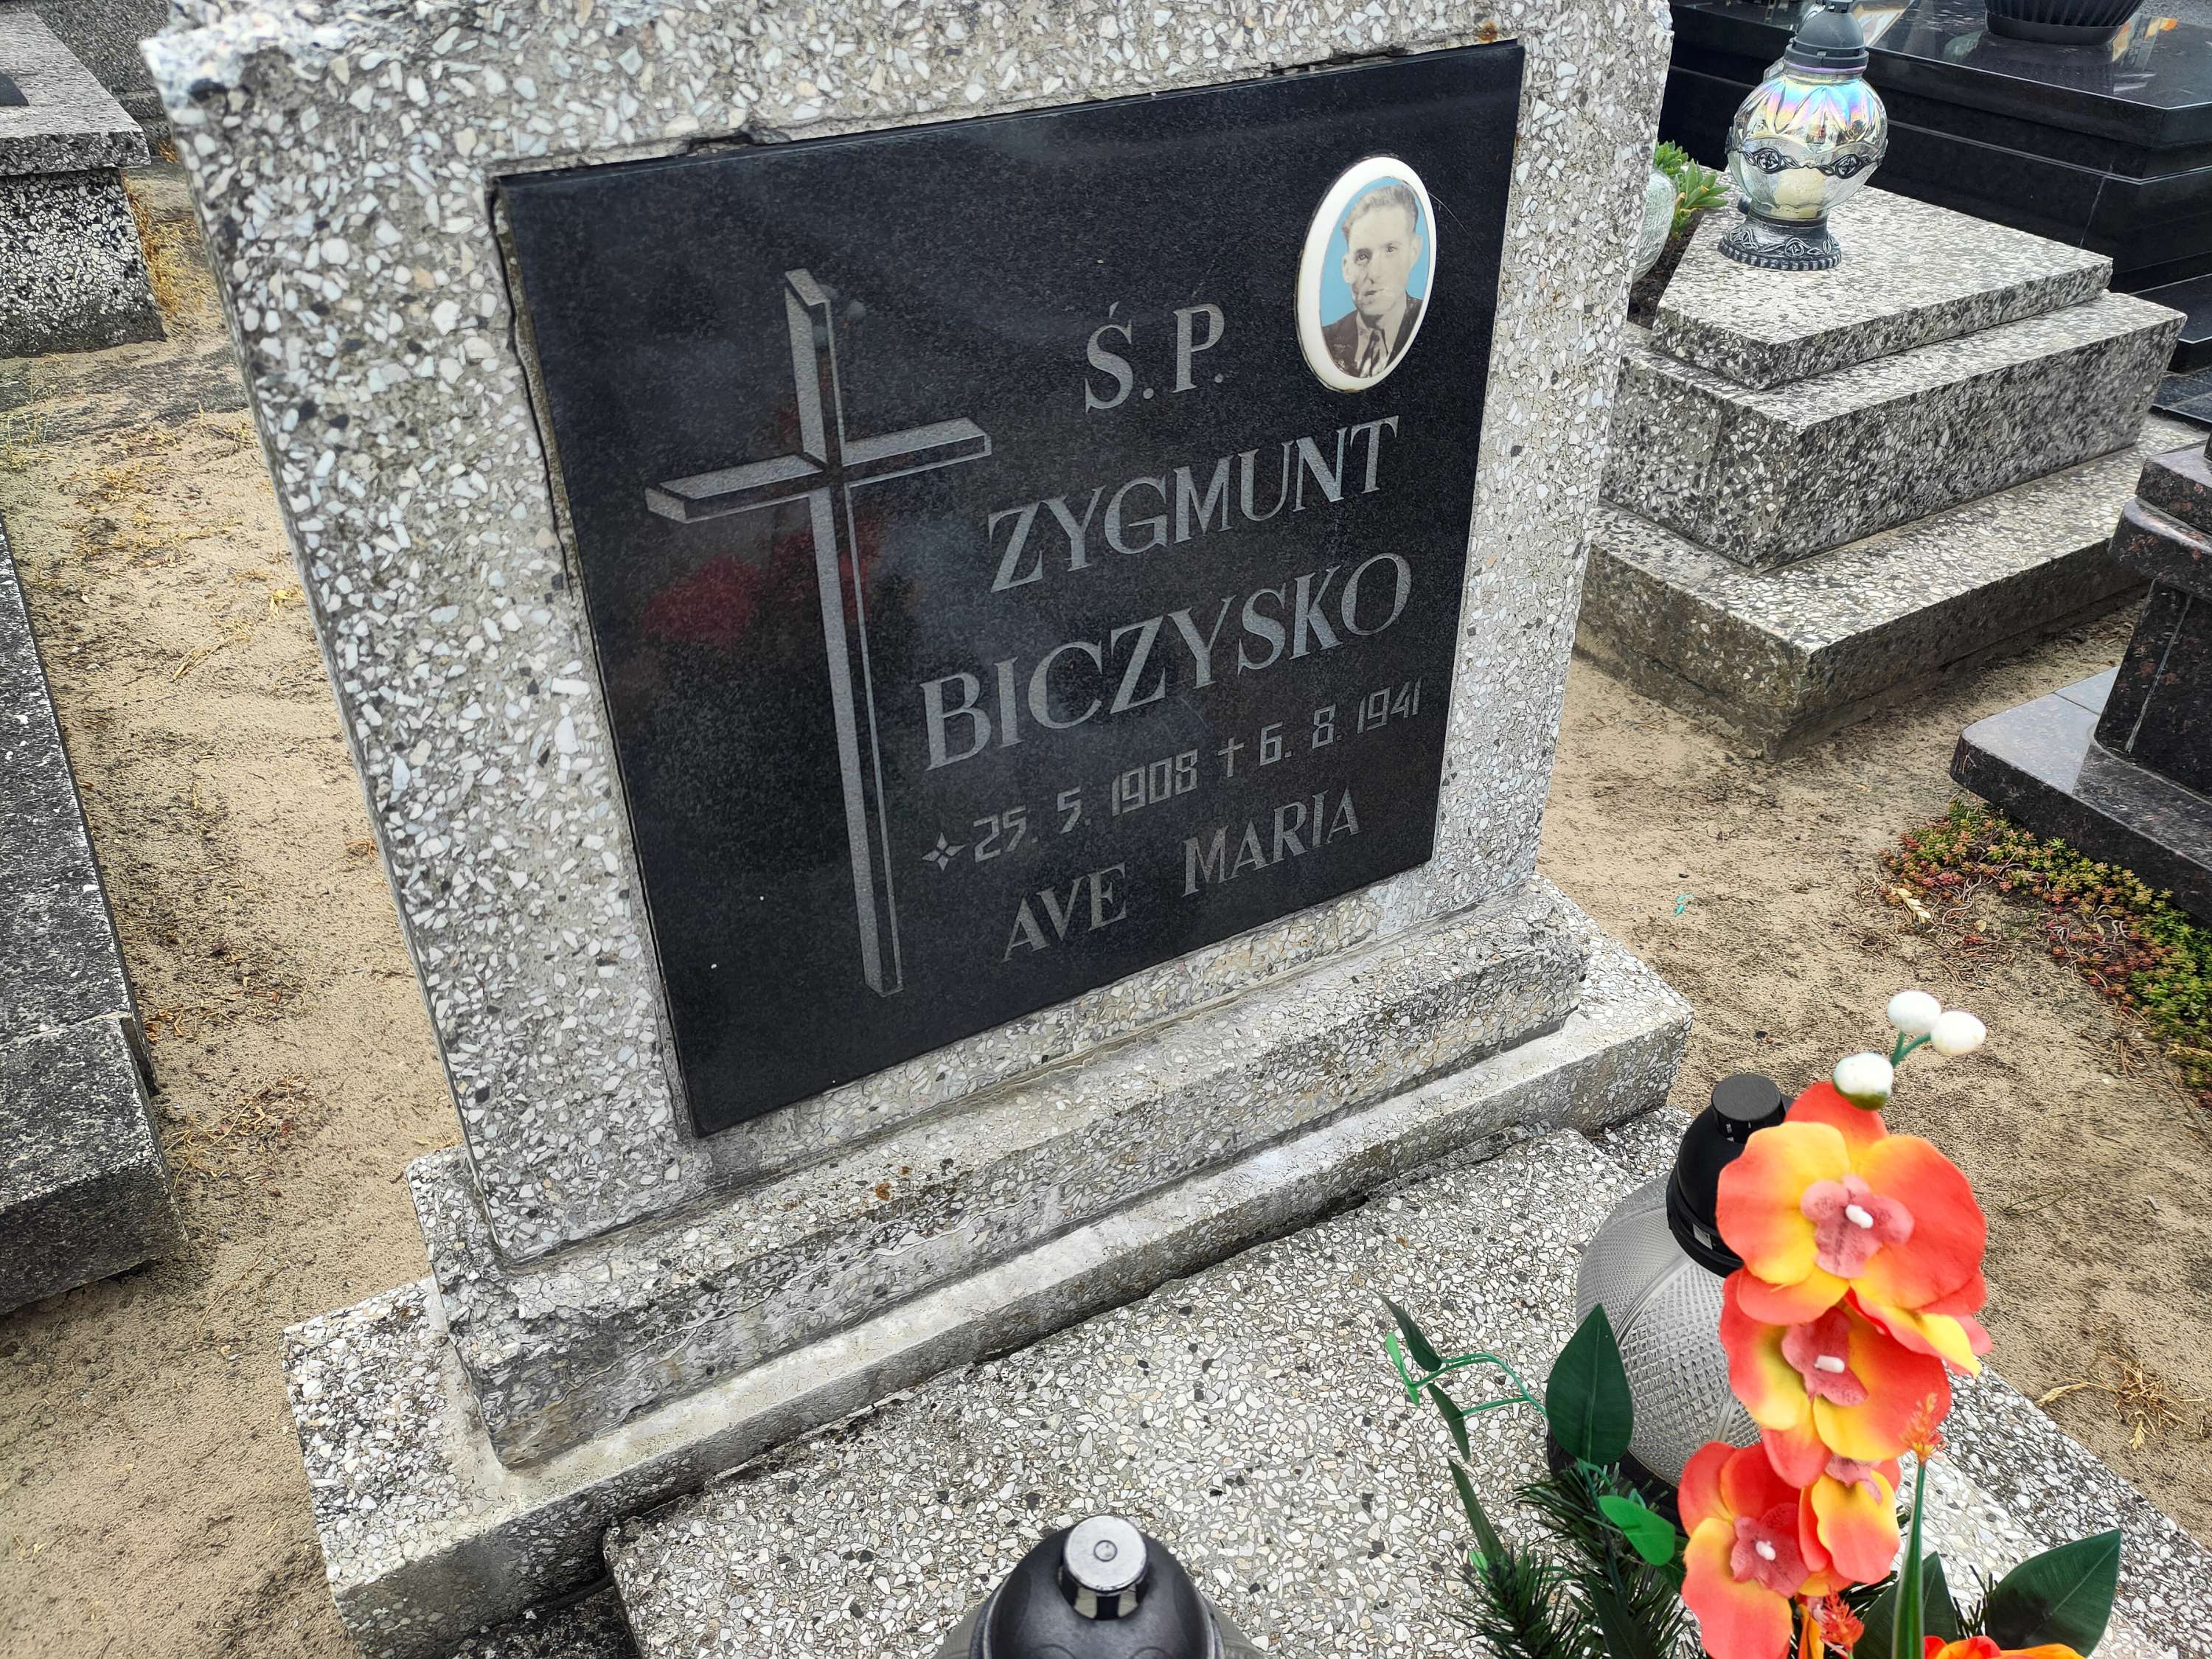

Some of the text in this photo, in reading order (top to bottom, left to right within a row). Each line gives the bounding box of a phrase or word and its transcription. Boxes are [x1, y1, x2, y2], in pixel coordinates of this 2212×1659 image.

[987, 416, 1399, 594] ZYGMUNT
[919, 552, 1412, 771] BICZYSKO
[1112, 748, 1198, 817] 1908
[1260, 723, 1292, 766] 6.
[1357, 678, 1422, 734] 1941
[1001, 785, 1360, 963] AVE MARIA
